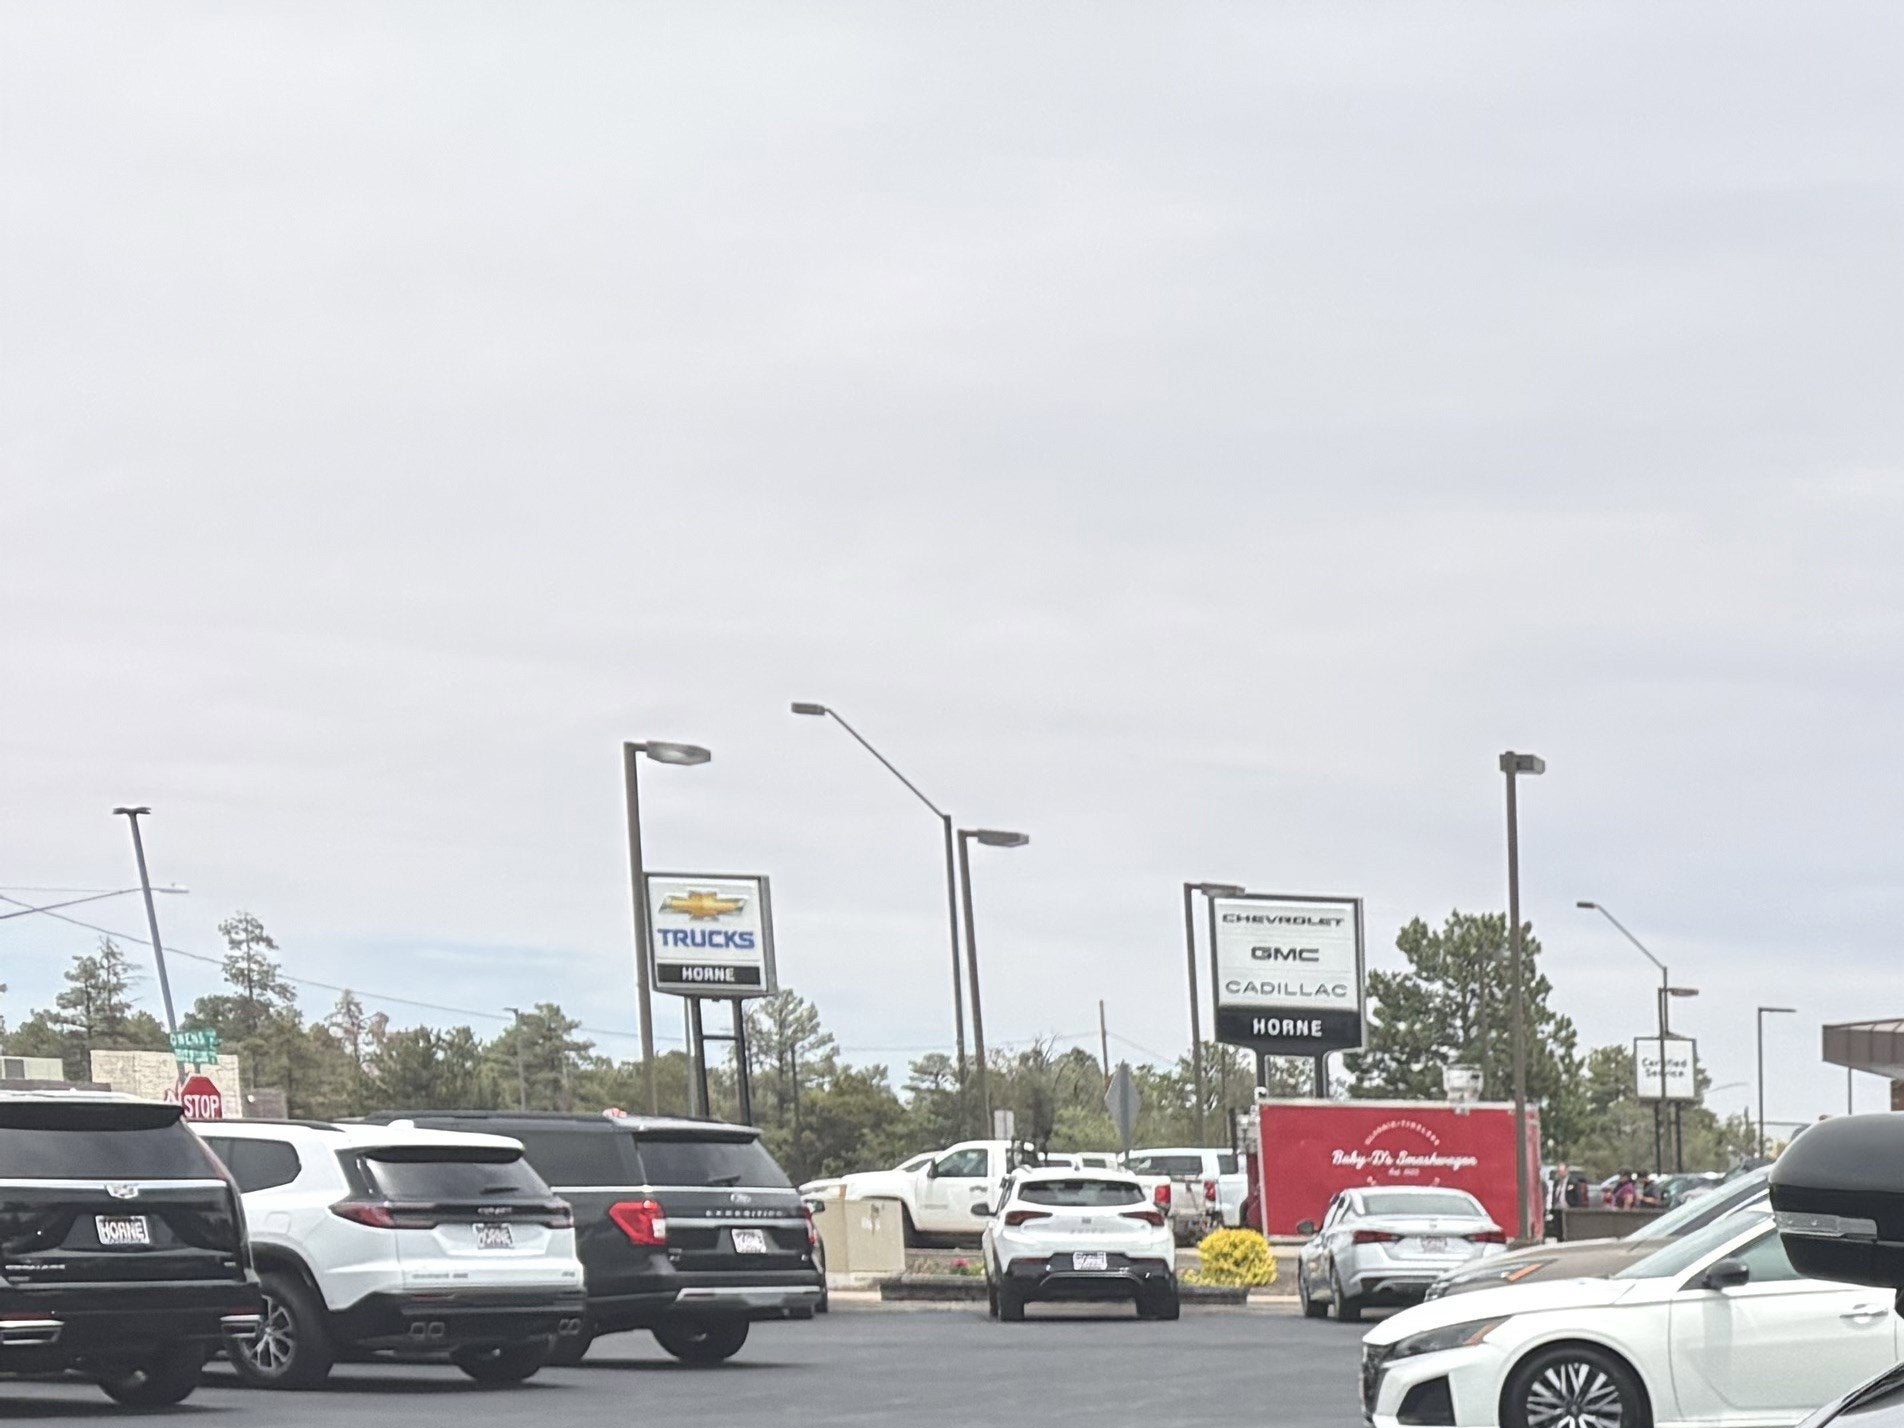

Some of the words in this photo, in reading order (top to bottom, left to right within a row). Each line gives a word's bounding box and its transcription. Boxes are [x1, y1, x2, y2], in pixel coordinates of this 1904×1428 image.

[1222, 913, 1344, 927] CHEVROLET
[657, 928, 755, 949] TRUCKS
[1251, 946, 1320, 962] GMC
[682, 967, 735, 982] HORNE
[1225, 980, 1348, 997] CADILLAC
[1253, 1018, 1323, 1037] HORNE
[183, 1094, 220, 1118] STOP
[101, 1221, 144, 1240] HORNE
